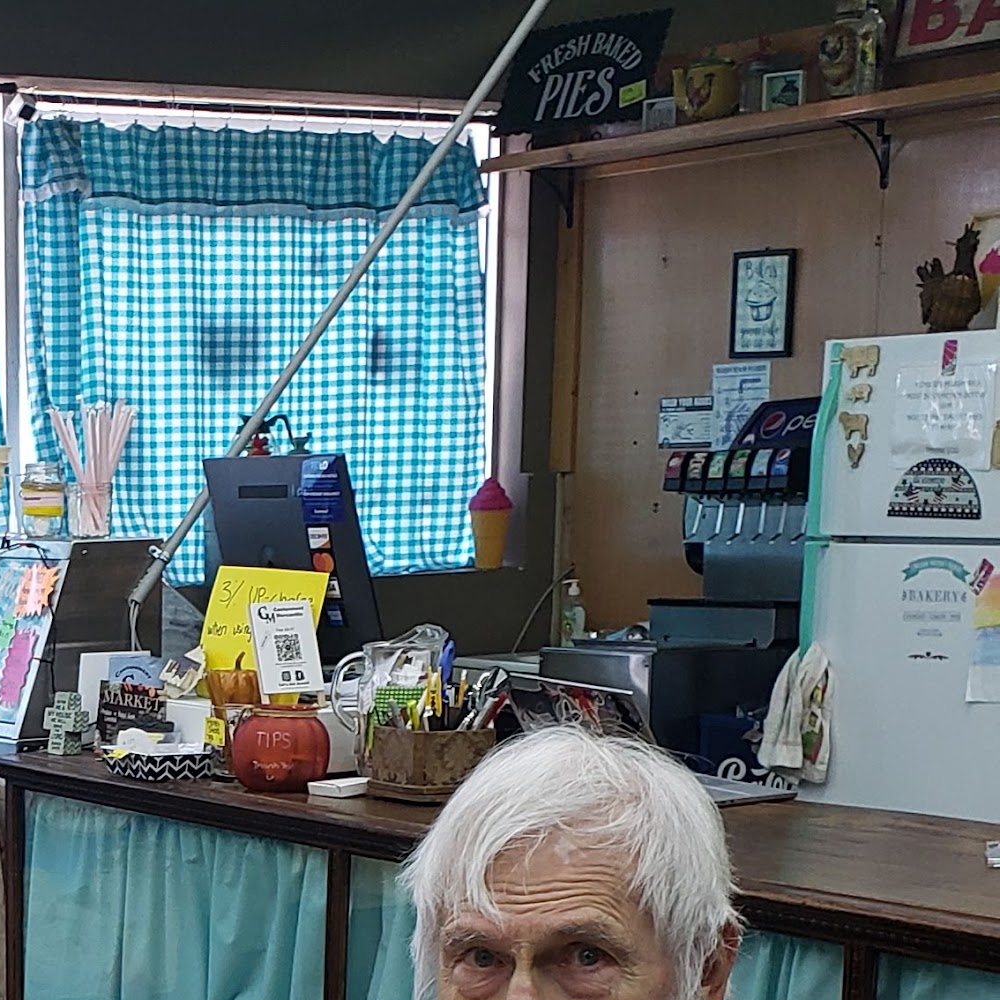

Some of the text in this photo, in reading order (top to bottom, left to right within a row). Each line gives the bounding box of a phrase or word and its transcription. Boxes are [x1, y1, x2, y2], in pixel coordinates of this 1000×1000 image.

[527, 31, 643, 84] FRESH BAKED
[534, 66, 615, 122] PIES
[909, 589, 958, 603] BAKERY
[102, 689, 161, 712] MARKET
[256, 730, 292, 750] TIPS
